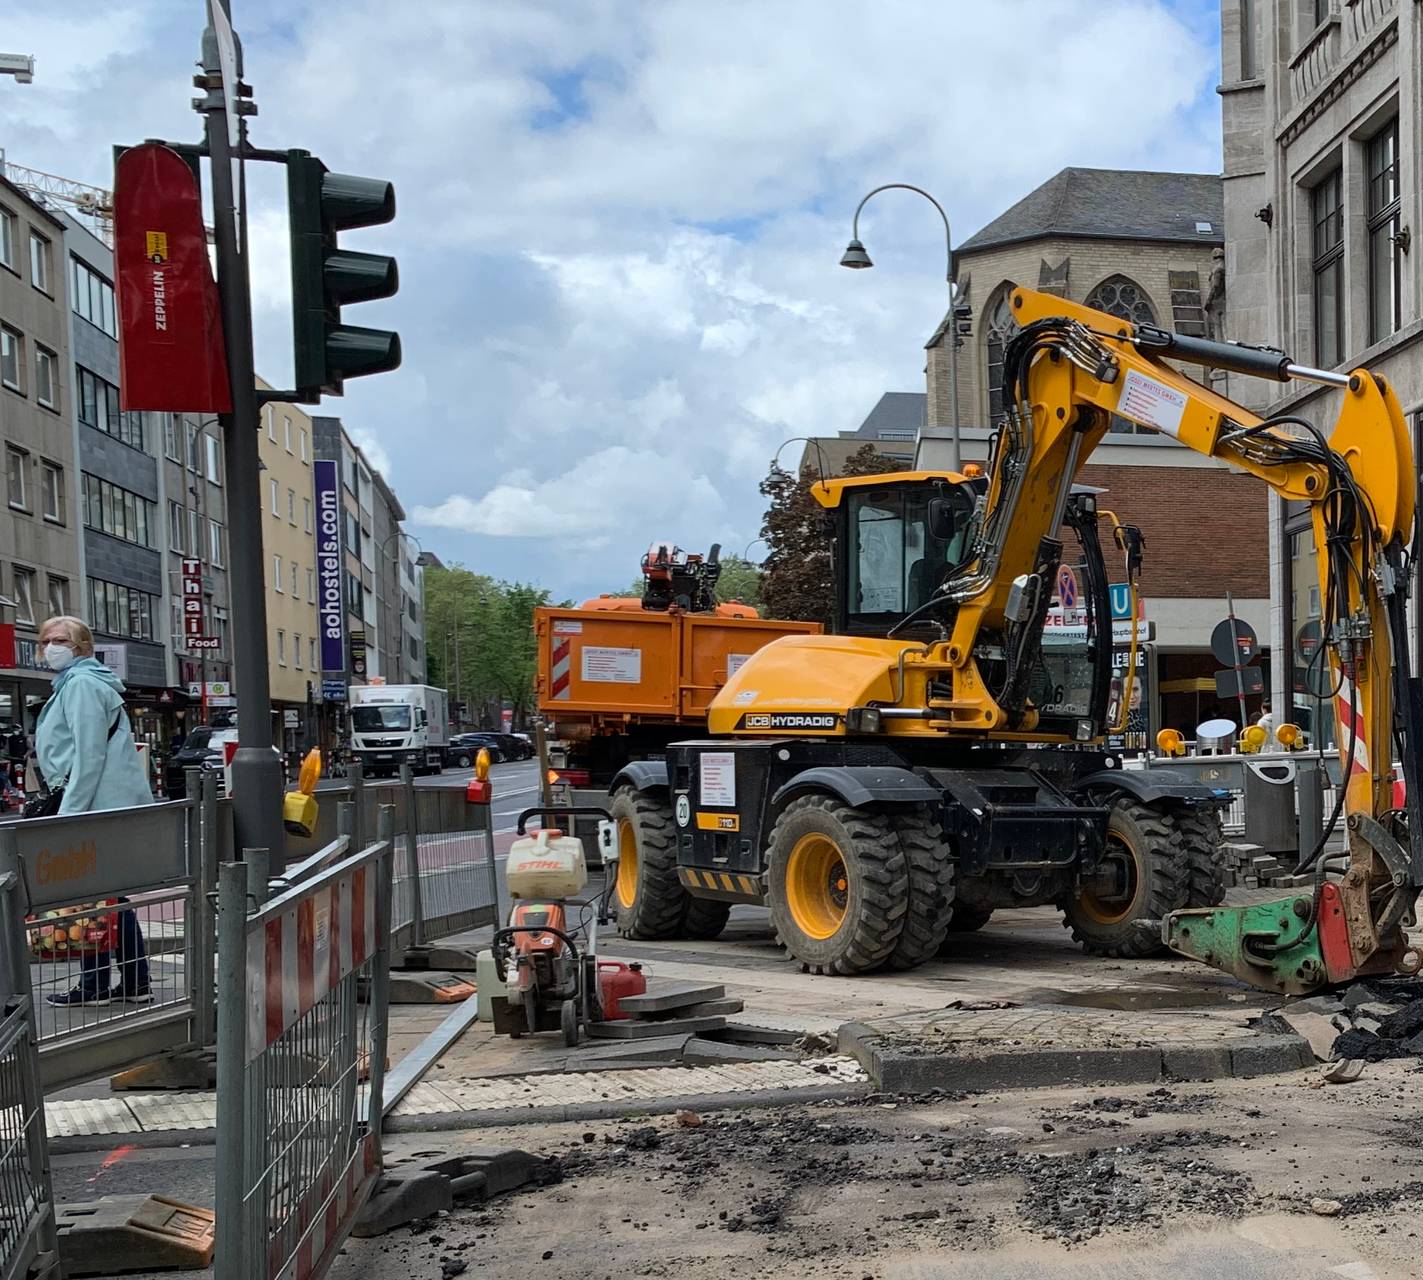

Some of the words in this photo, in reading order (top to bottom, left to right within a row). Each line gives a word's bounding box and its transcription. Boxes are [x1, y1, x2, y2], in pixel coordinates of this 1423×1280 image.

[153, 271, 166, 331] ZEPPELIN
[319, 490, 341, 639] aohostels.com
[183, 559, 201, 633] Thai
[1113, 588, 1129, 614] U
[187, 638, 219, 648] Food
[747, 716, 769, 727] JCB
[771, 716, 834, 727] HYDRADIG
[679, 802, 687, 819] 20
[516, 861, 564, 871] STIHL
